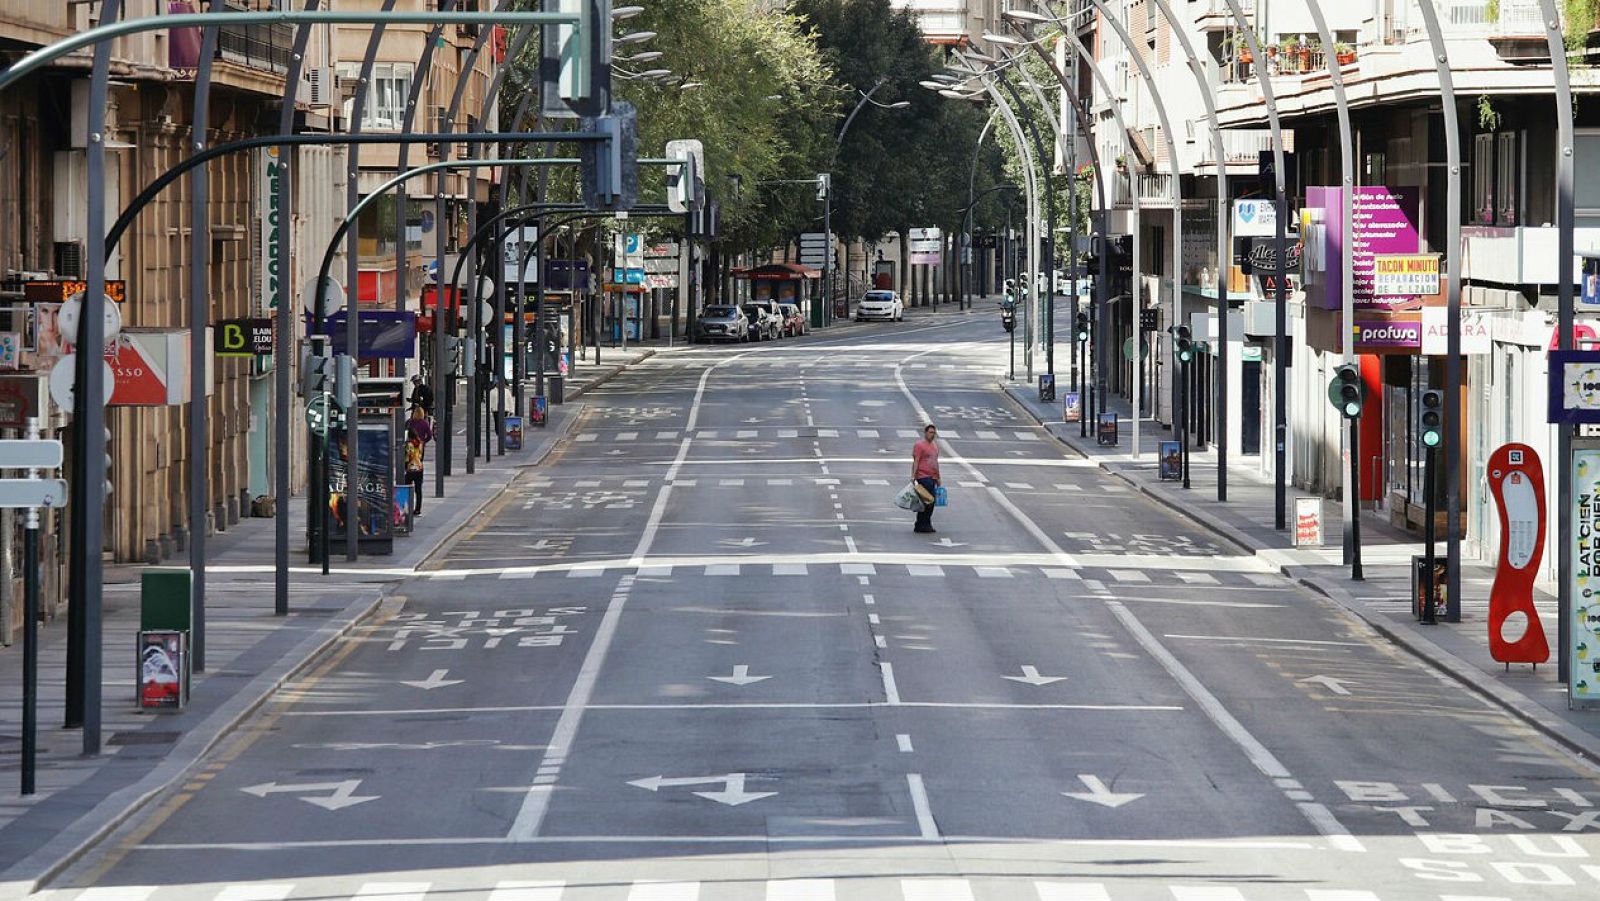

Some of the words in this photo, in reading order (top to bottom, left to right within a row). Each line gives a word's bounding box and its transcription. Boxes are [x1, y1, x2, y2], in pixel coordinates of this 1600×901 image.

[1377, 260, 1403, 272] TACON
[1407, 259, 1438, 271] MINUTO
[224, 323, 245, 349] B
[1363, 326, 1417, 341] profusa
[1333, 780, 1594, 807] BICI
